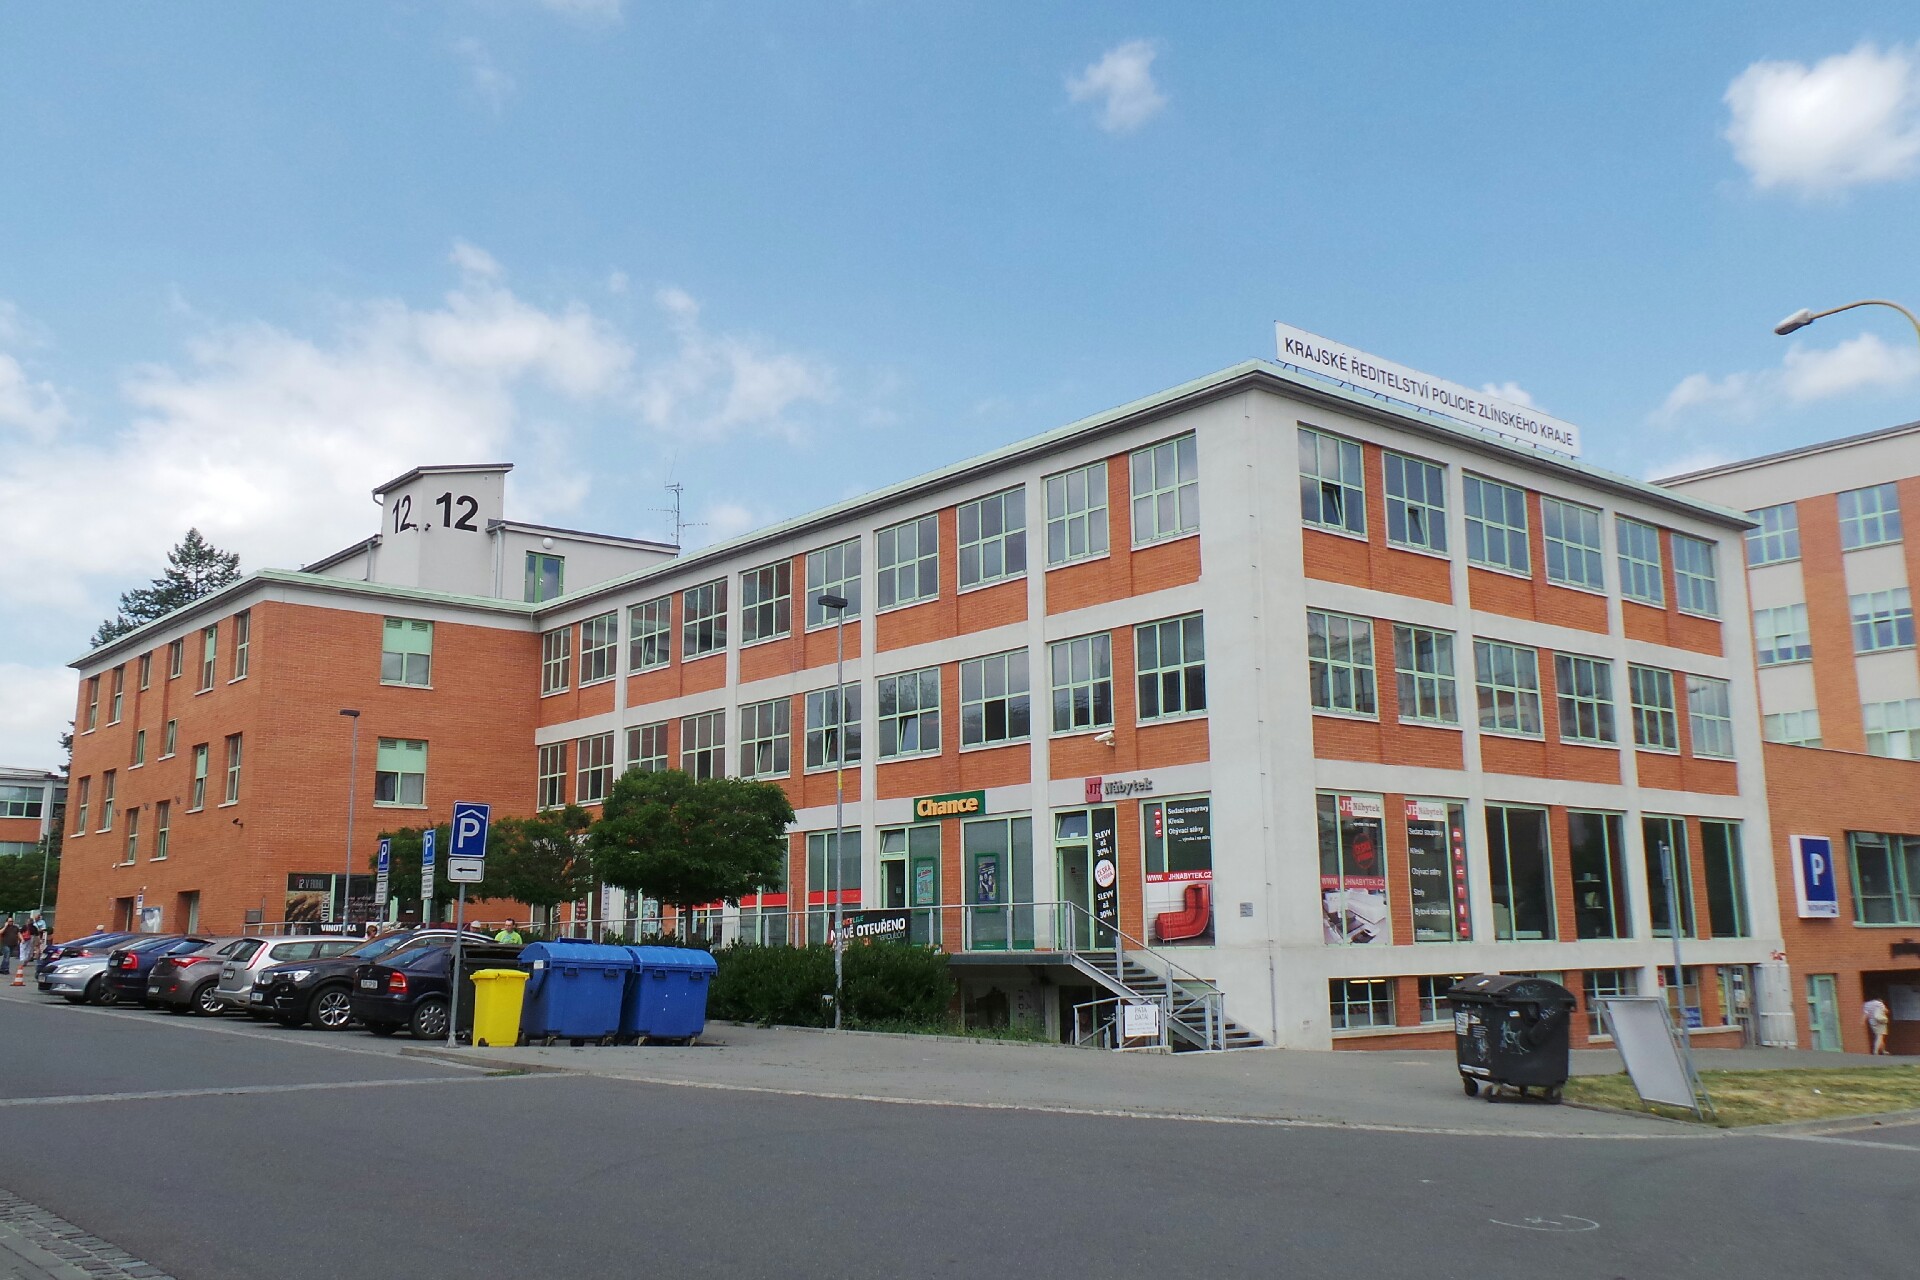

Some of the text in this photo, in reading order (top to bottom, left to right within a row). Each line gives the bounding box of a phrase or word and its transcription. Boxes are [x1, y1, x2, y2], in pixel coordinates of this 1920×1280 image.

[1285, 337, 1574, 447] KRAJSKÉ ŘEDITELSTVÍ POLICIE ZLÍNSKÉHO KRAJE
[392, 494, 417, 534] 12
[435, 491, 479, 533] 12
[1104, 777, 1153, 796] Nábytek
[917, 797, 979, 817] Chance
[1353, 802, 1381, 814] Nábytek
[457, 817, 480, 848] P
[1094, 828, 1111, 841] SLEVY
[1168, 871, 1213, 881] JHNABYTEK.CZ
[1810, 852, 1825, 886] P
[1097, 889, 1114, 901] SLEVY
[320, 924, 357, 932] VINOTKA
[856, 917, 906, 937] OTEVŘENO
